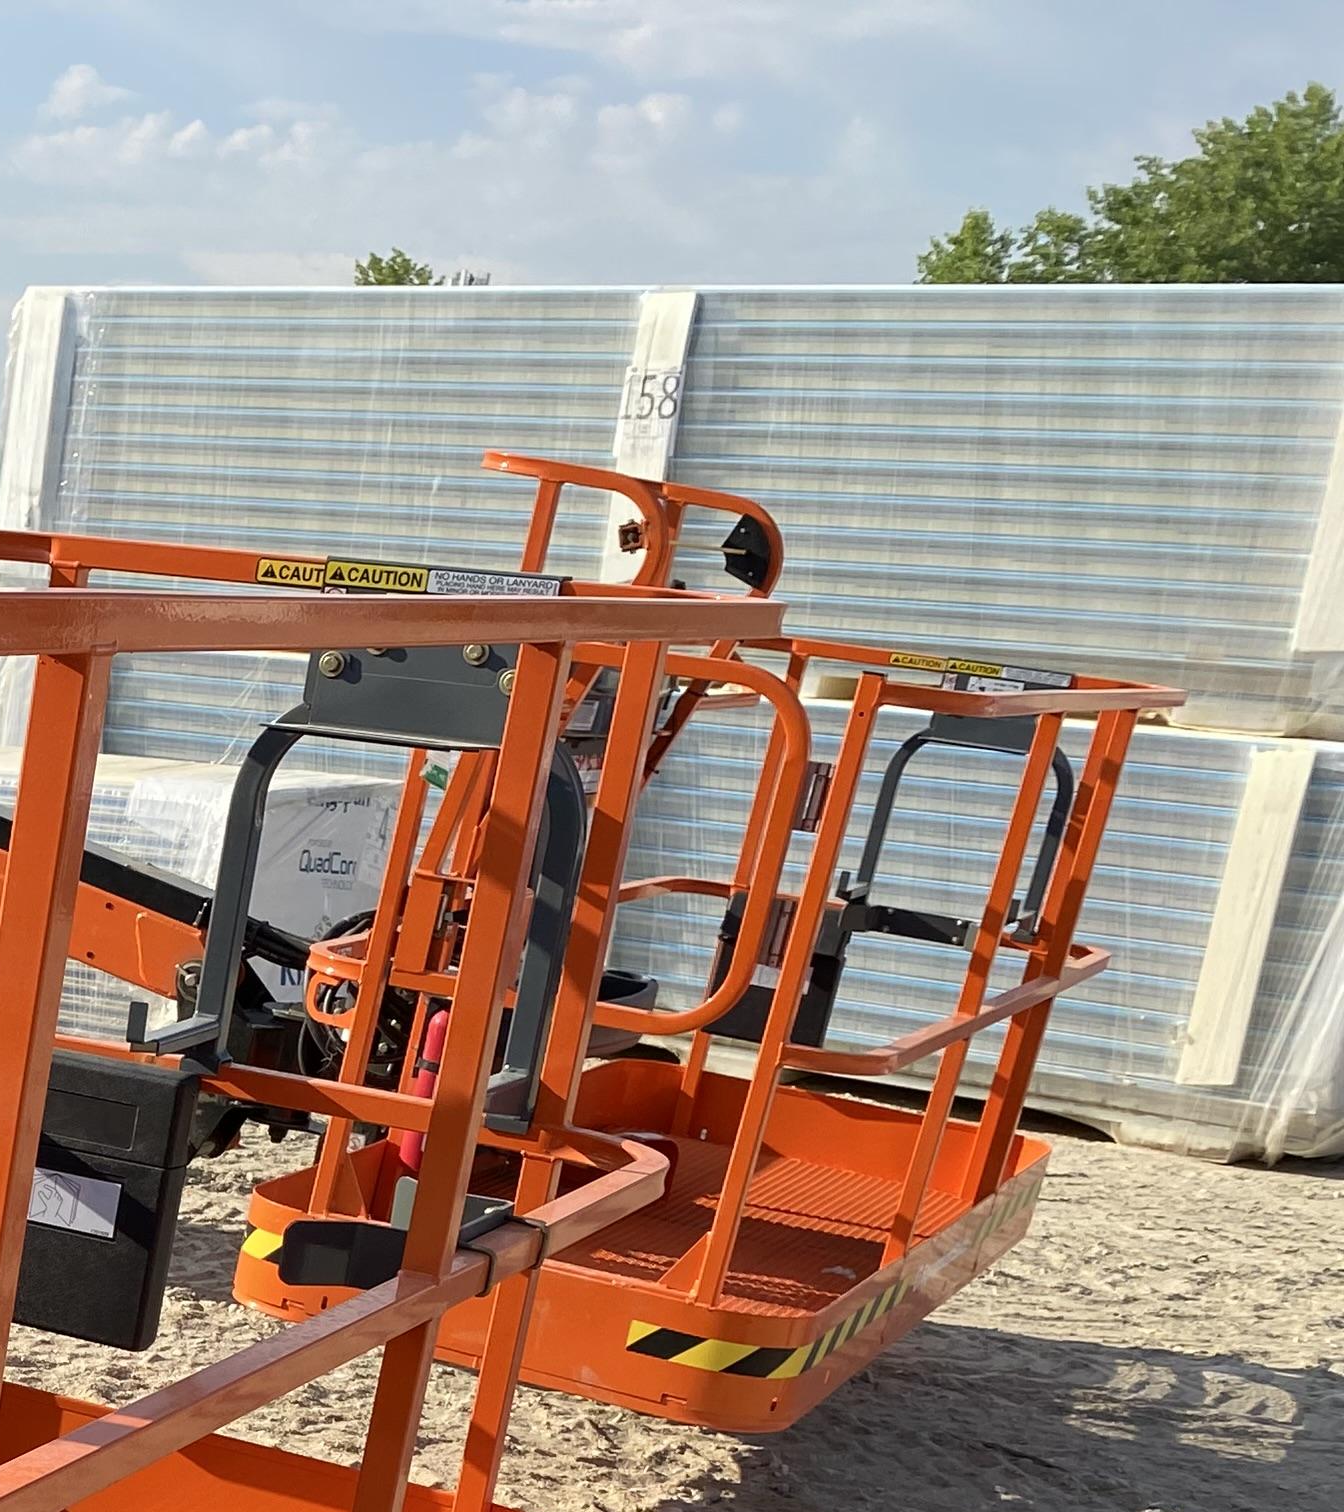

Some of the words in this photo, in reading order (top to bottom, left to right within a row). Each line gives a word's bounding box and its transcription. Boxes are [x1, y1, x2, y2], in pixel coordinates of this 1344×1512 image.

[620, 375, 680, 419] 158
[348, 567, 424, 589] CAUTION
[434, 572, 450, 581] NO
[452, 574, 486, 584] HANDS
[489, 576, 504, 585] OR
[506, 578, 553, 590] LANYARD
[901, 656, 942, 669] CAUTION
[957, 663, 1000, 676] CAUTION
